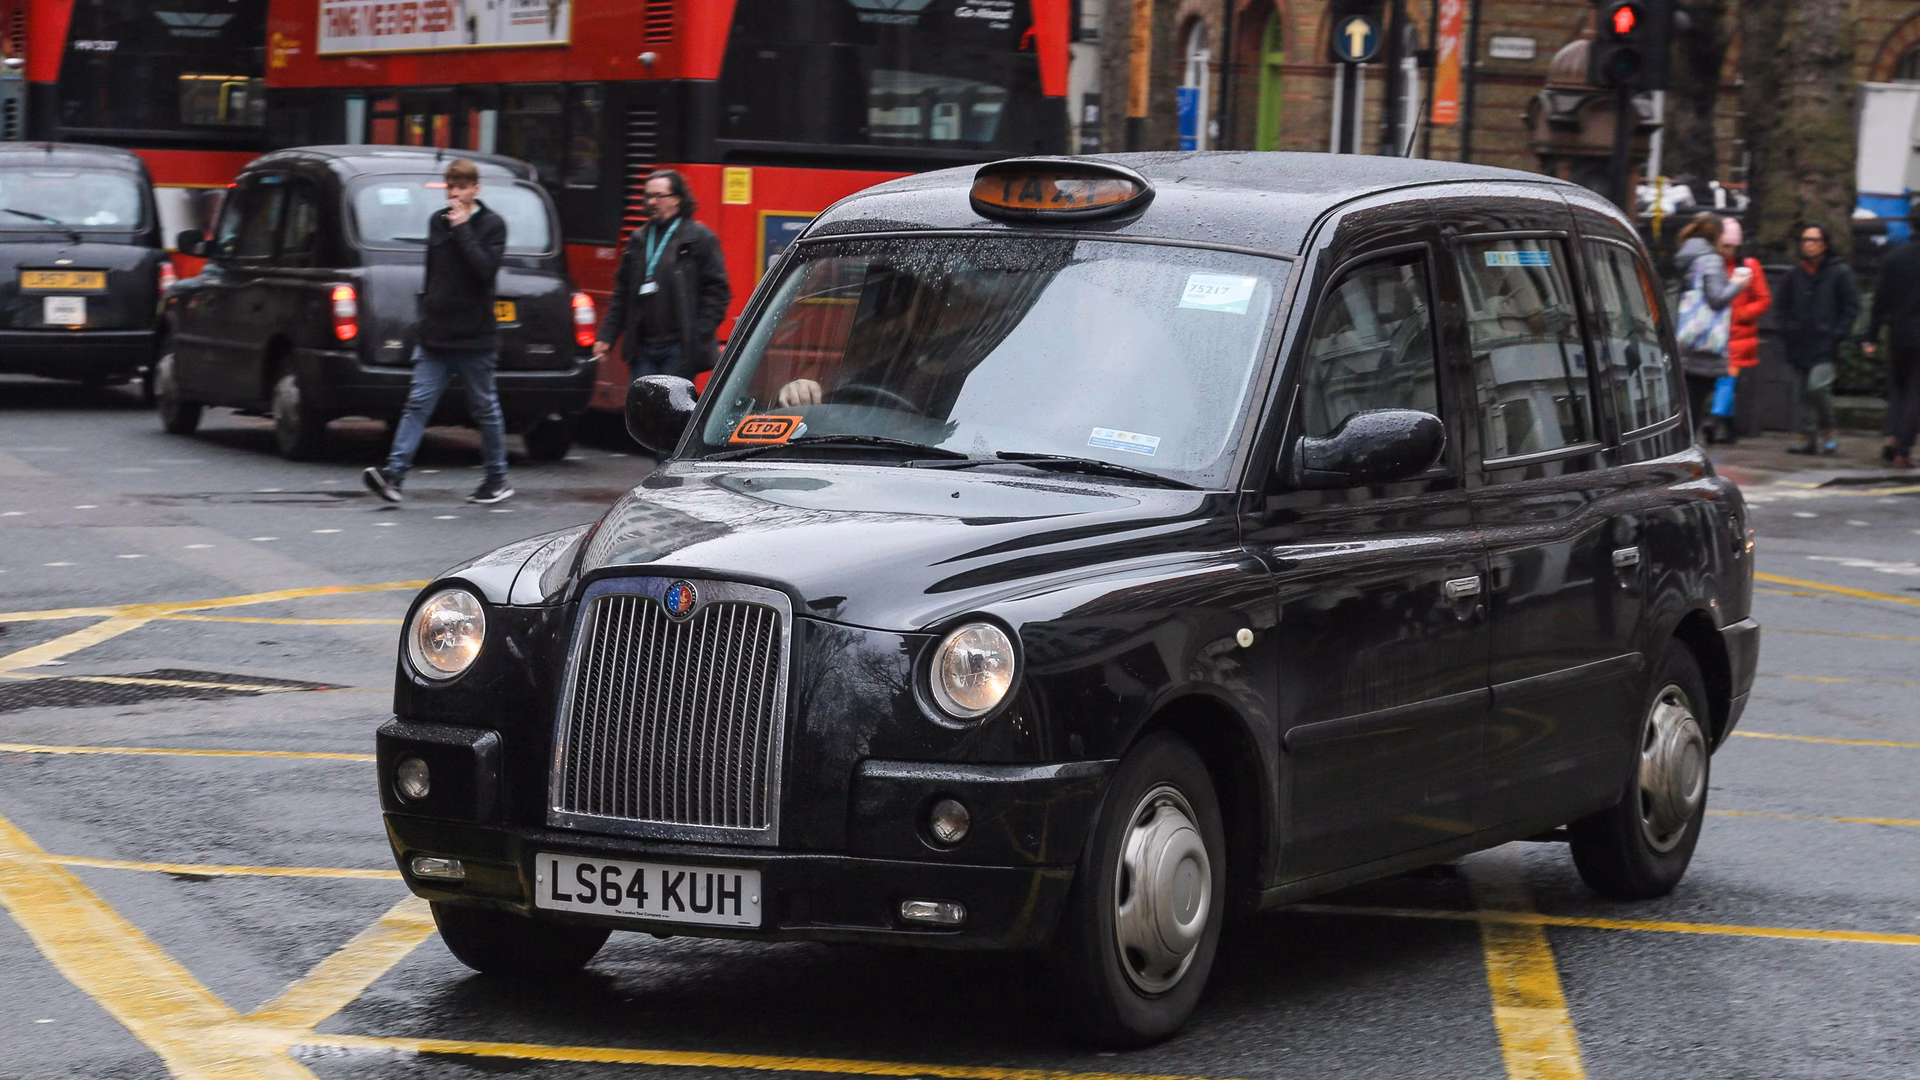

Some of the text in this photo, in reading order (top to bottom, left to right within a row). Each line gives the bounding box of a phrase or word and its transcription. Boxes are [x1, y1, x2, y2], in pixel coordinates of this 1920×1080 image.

[1001, 174, 1097, 203] TAXI
[1189, 284, 1230, 294] 75217
[746, 424, 782, 432] LTDA
[552, 860, 742, 916] LS64 KUH
